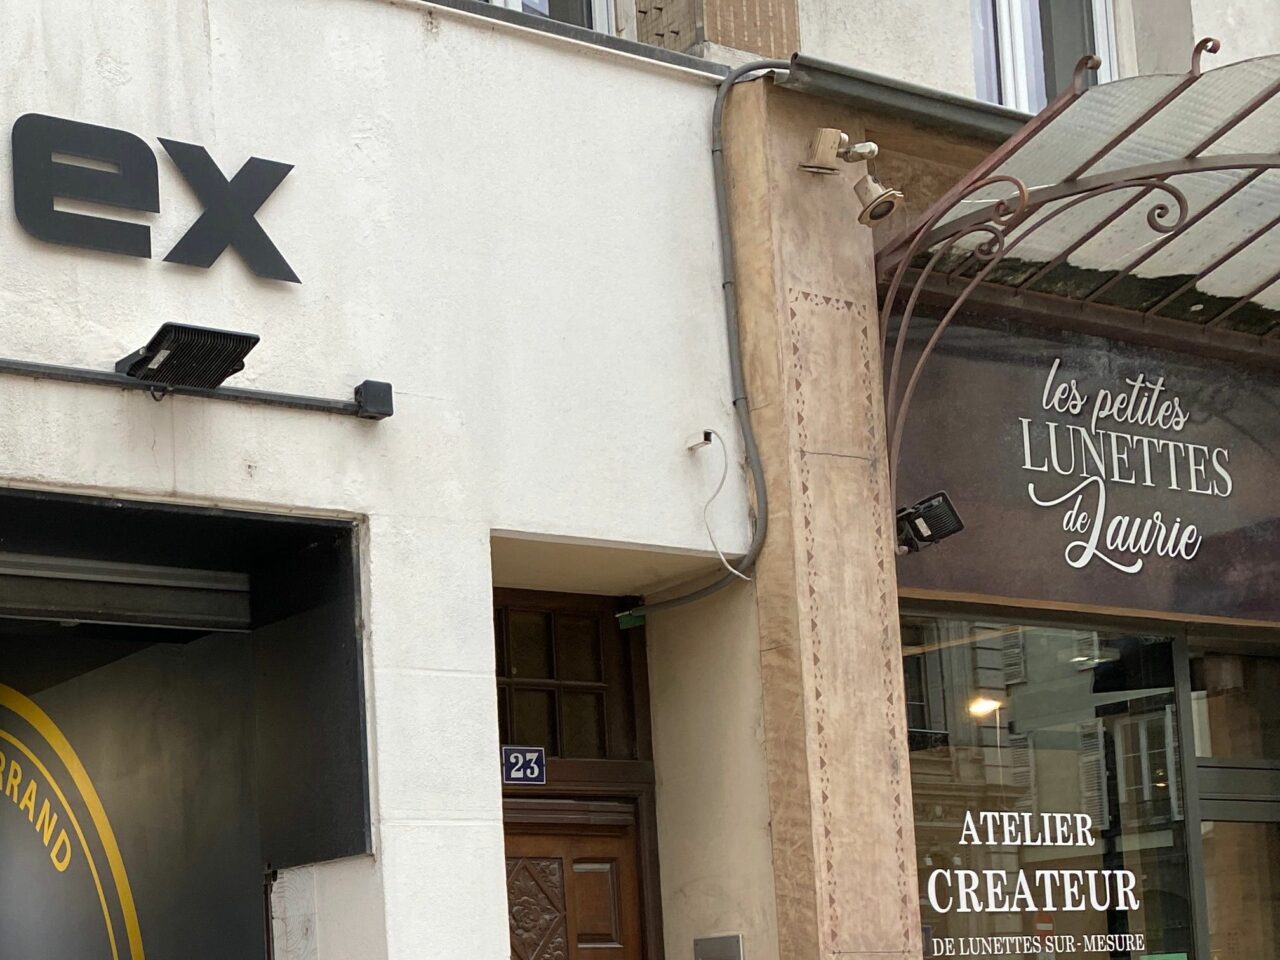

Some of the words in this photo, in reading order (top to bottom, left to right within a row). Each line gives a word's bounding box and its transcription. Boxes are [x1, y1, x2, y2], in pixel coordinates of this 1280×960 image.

[1041, 358, 1088, 415] les
[1090, 373, 1190, 434] petites
[1018, 417, 1234, 498] LUNETTES
[1028, 475, 1202, 574] Laurie
[1062, 494, 1092, 534] de
[509, 752, 539, 778] 23
[958, 810, 1096, 847] ATELIER
[926, 868, 1140, 914] CREATEUR
[932, 937, 956, 957] DE
[959, 935, 1042, 956] LUNETTES
